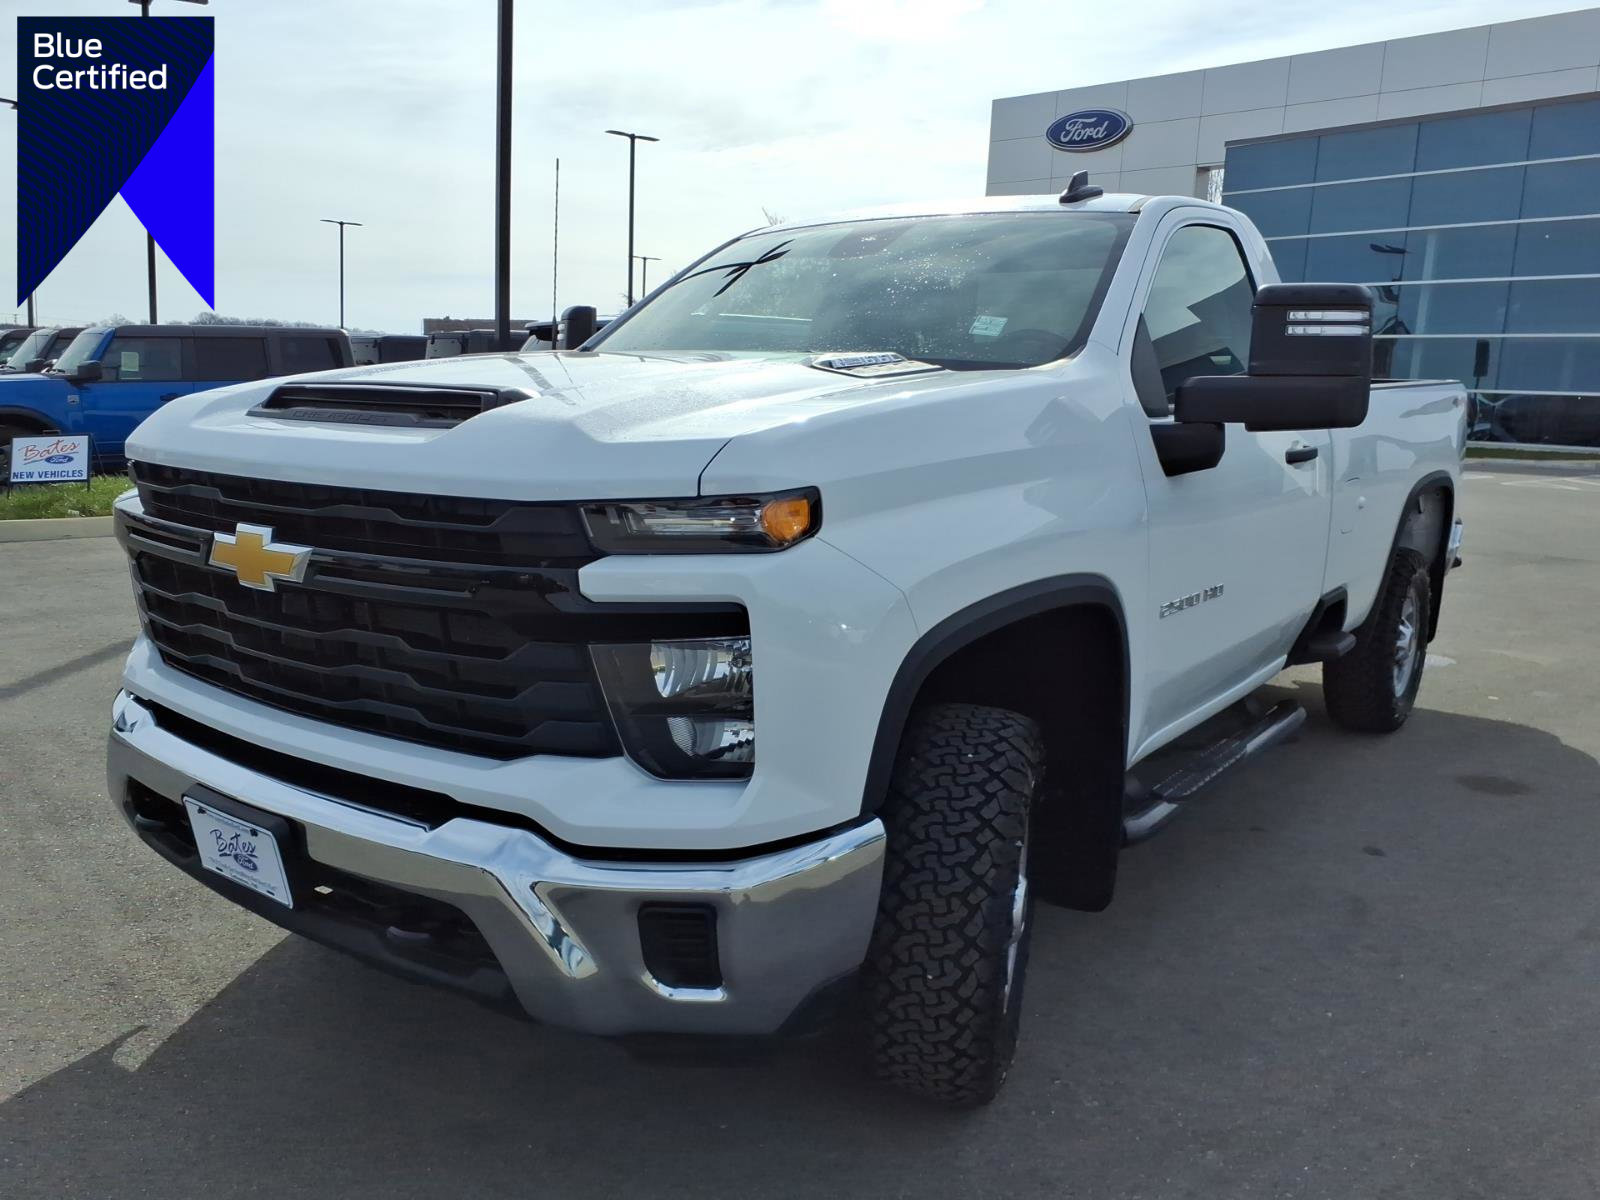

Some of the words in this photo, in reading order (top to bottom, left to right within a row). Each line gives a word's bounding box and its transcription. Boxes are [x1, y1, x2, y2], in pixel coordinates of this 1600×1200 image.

[1060, 117, 1110, 142] Ford
[18, 440, 80, 461] Bates
[12, 471, 35, 480] NEW
[38, 469, 84, 479] VEHICLES
[209, 828, 257, 854] Bates
